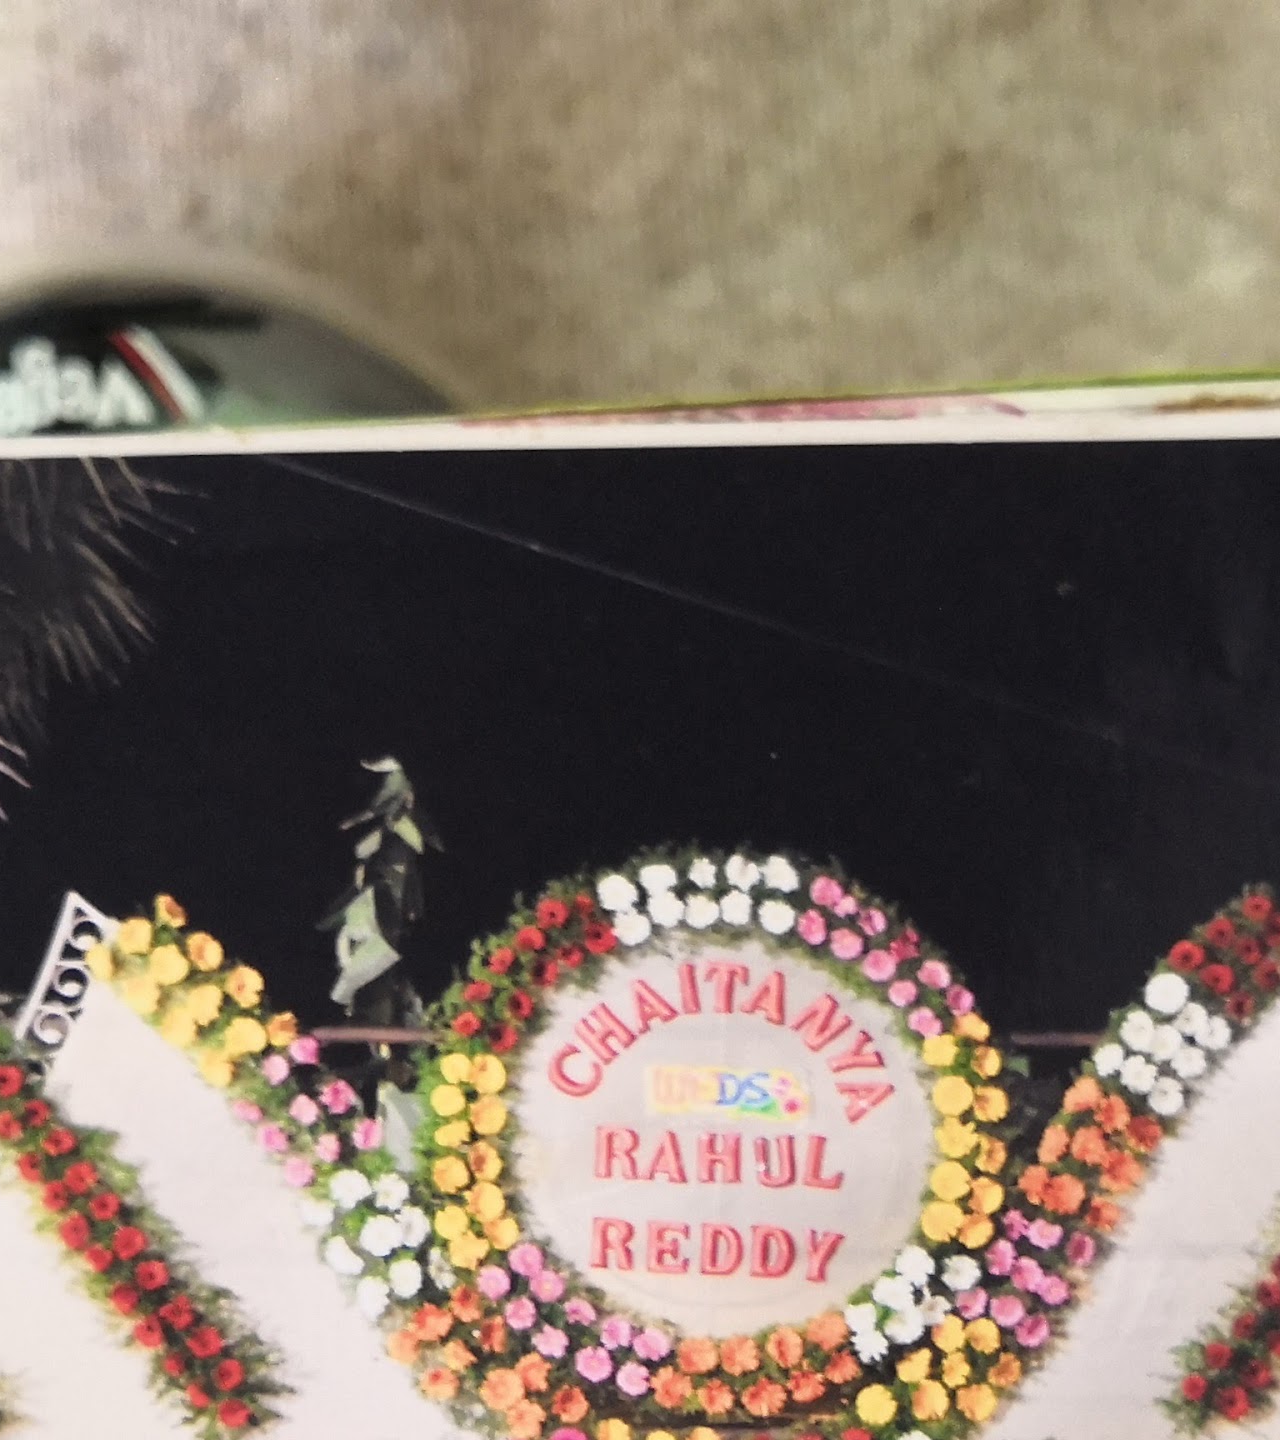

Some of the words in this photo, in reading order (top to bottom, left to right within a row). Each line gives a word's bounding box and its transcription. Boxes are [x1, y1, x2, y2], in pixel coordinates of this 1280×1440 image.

[547, 961, 896, 1126] CHAITANYA
[594, 1125, 845, 1190] RAHUL
[590, 1216, 846, 1284] REDDY
